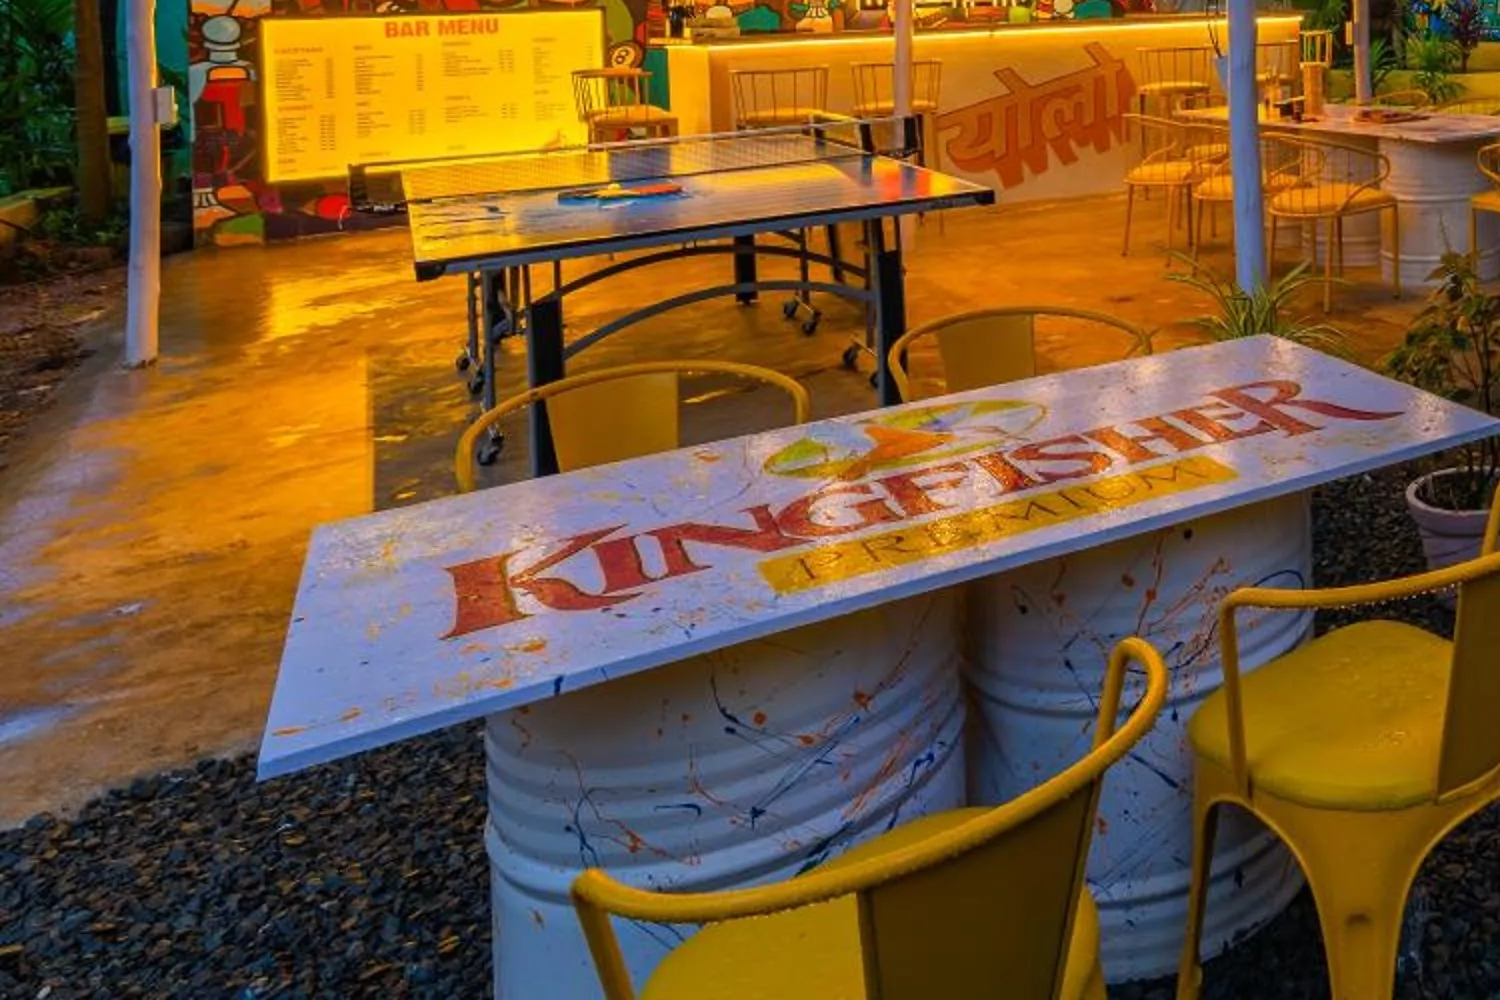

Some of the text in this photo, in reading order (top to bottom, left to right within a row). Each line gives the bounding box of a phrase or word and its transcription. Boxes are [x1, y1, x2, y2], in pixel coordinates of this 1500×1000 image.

[384, 18, 499, 38] BAR MENU
[439, 379, 1405, 640] KINGFISHER
